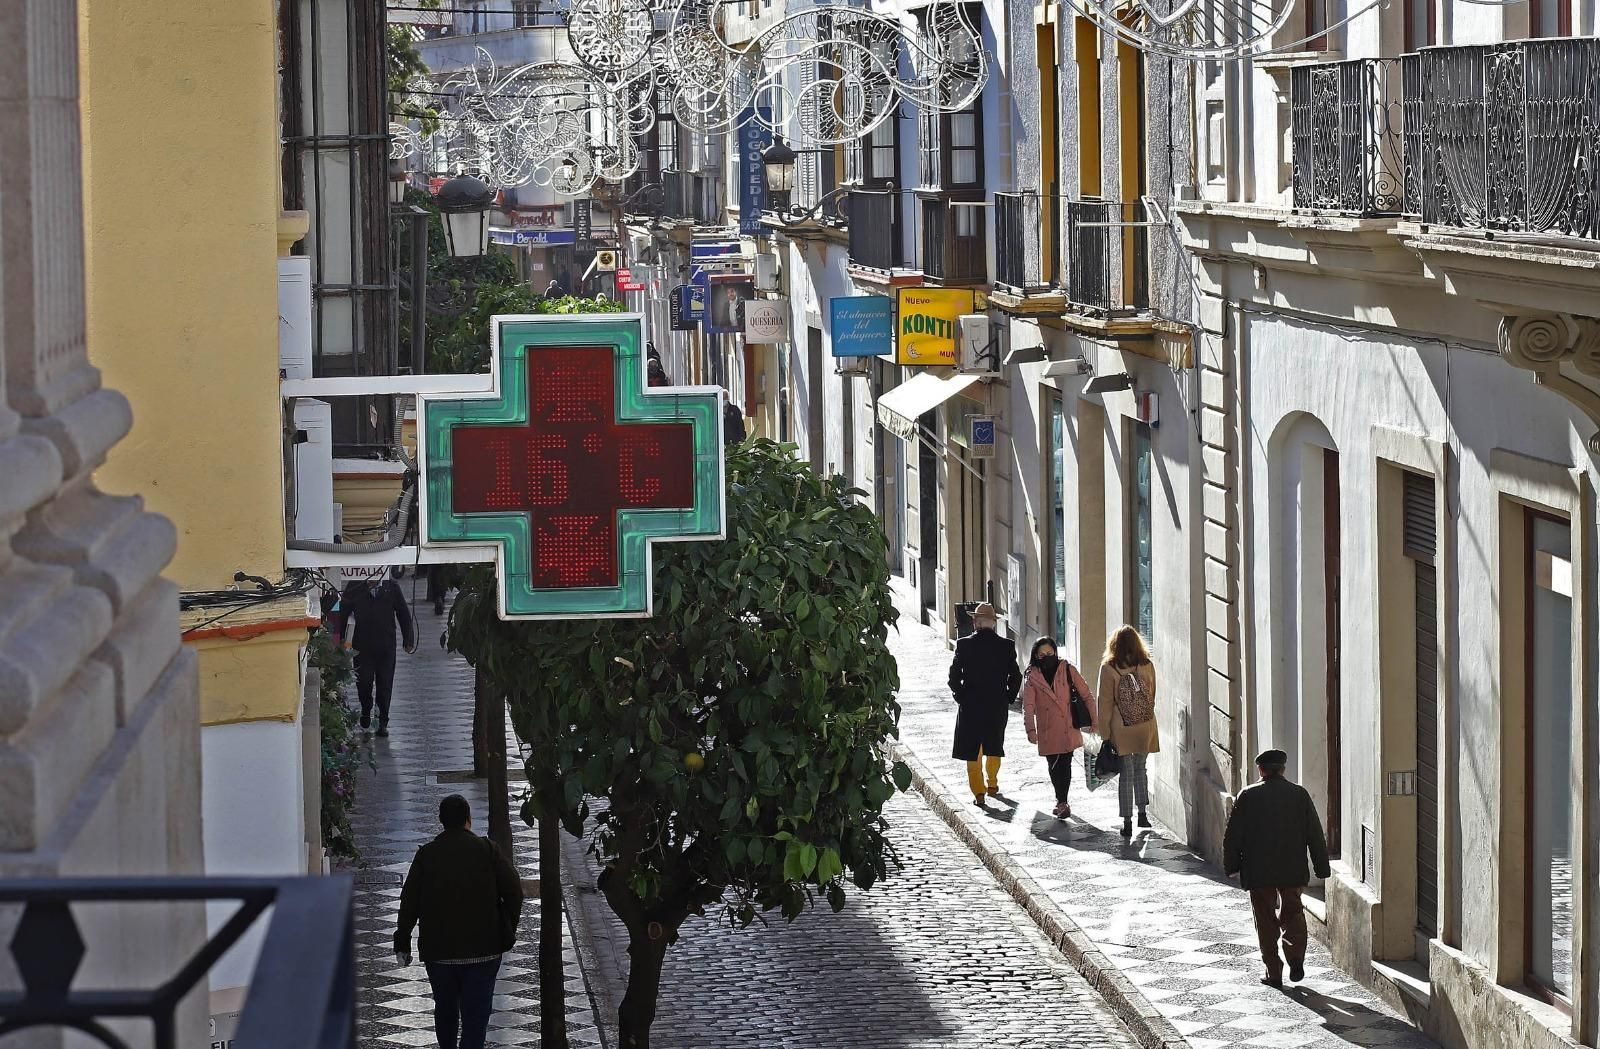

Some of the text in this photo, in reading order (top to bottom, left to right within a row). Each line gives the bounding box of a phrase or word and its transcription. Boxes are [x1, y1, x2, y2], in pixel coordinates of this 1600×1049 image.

[748, 119, 761, 218] LOGOPEDIA
[905, 296, 930, 304] NUEVO
[836, 310, 848, 319] El
[854, 319, 870, 329] del
